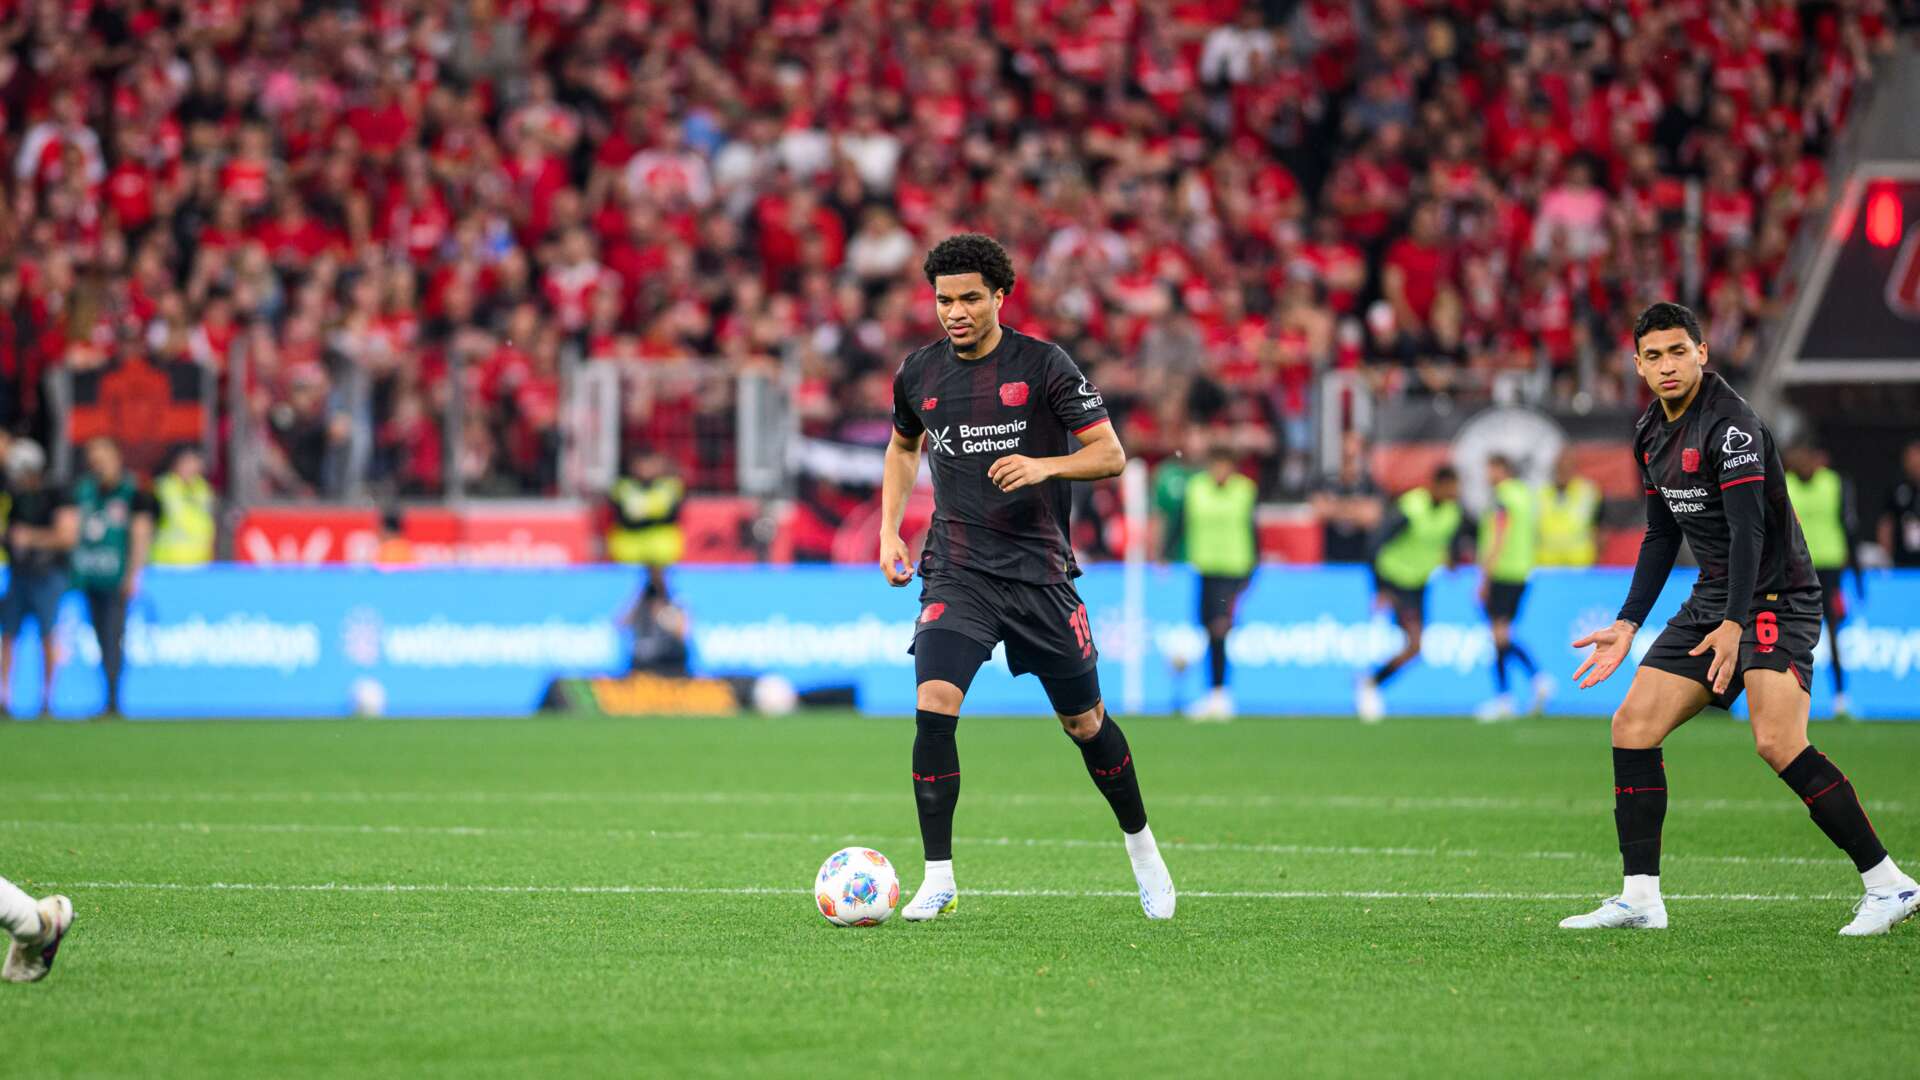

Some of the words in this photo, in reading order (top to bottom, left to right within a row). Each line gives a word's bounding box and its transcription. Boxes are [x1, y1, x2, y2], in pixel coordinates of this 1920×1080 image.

[959, 419, 1027, 438] Barmenia
[962, 437, 1020, 453] Gothaer
[1723, 452, 1759, 470] NIEDAX
[1661, 486, 1708, 499] Barmenia
[1669, 500, 1706, 512] Gothaer
[1756, 611, 1779, 645] 6
